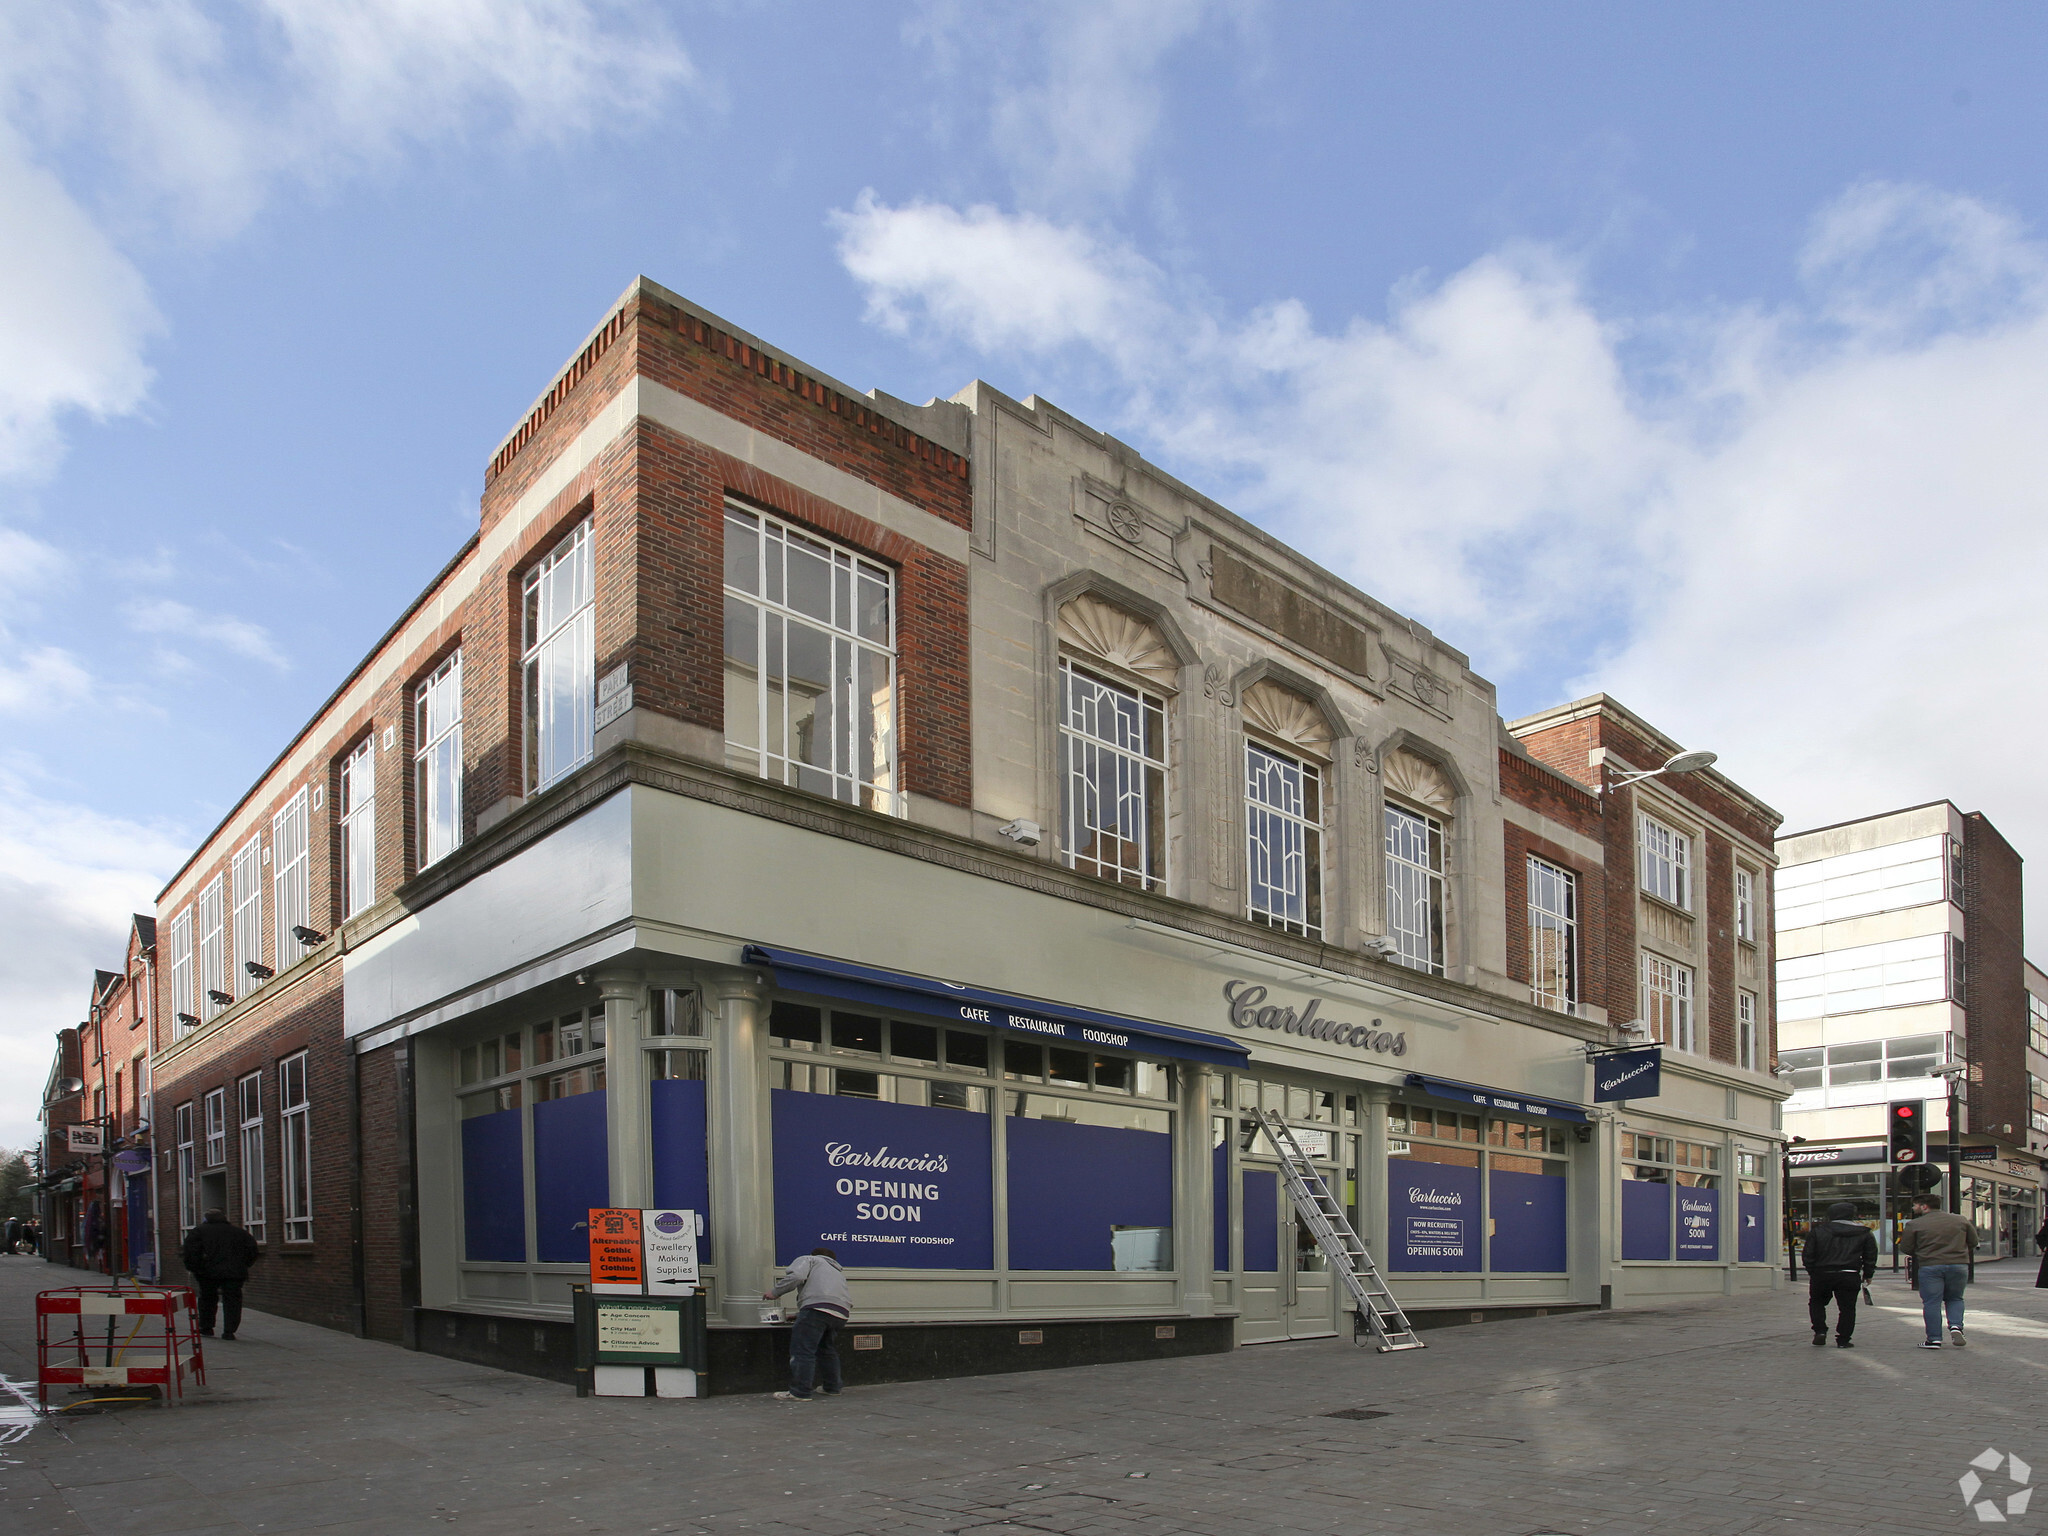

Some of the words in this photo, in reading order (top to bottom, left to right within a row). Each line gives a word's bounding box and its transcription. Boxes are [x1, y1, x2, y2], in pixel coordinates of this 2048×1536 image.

[602, 669, 626, 697] PARK
[597, 693, 629, 725] STREET
[960, 1006, 991, 1023] CAFFE
[1008, 1015, 1066, 1036] RESTAURANT
[1083, 1028, 1129, 1047] FOODSHOP
[1600, 1061, 1655, 1091] Carluccio's
[1494, 1098, 1520, 1111] RESTAURANT
[1526, 1104, 1548, 1115] FOODSHOP
[824, 1141, 949, 1173] Carluccio's
[1787, 1151, 1840, 1165] xpress
[836, 1178, 939, 1201] OPENING
[1408, 1186, 1462, 1205] Carluccio's
[856, 1203, 921, 1222] SOON
[590, 1210, 639, 1231] Salamander
[1427, 1221, 1458, 1229] RECRUITING
[1684, 1216, 1710, 1227] OPING
[820, 1231, 848, 1242] CAFFÉ
[851, 1234, 906, 1244] RESTAURANT
[910, 1236, 955, 1245] FOODSHOP
[1688, 1229, 1706, 1238] SOON
[650, 1243, 693, 1253] Jewellery
[1407, 1247, 1441, 1256] OPENING
[1442, 1247, 1464, 1257] SOON
[658, 1254, 689, 1264] Making
[600, 1264, 636, 1272] Clothing
[656, 1266, 693, 1276] Supplies
